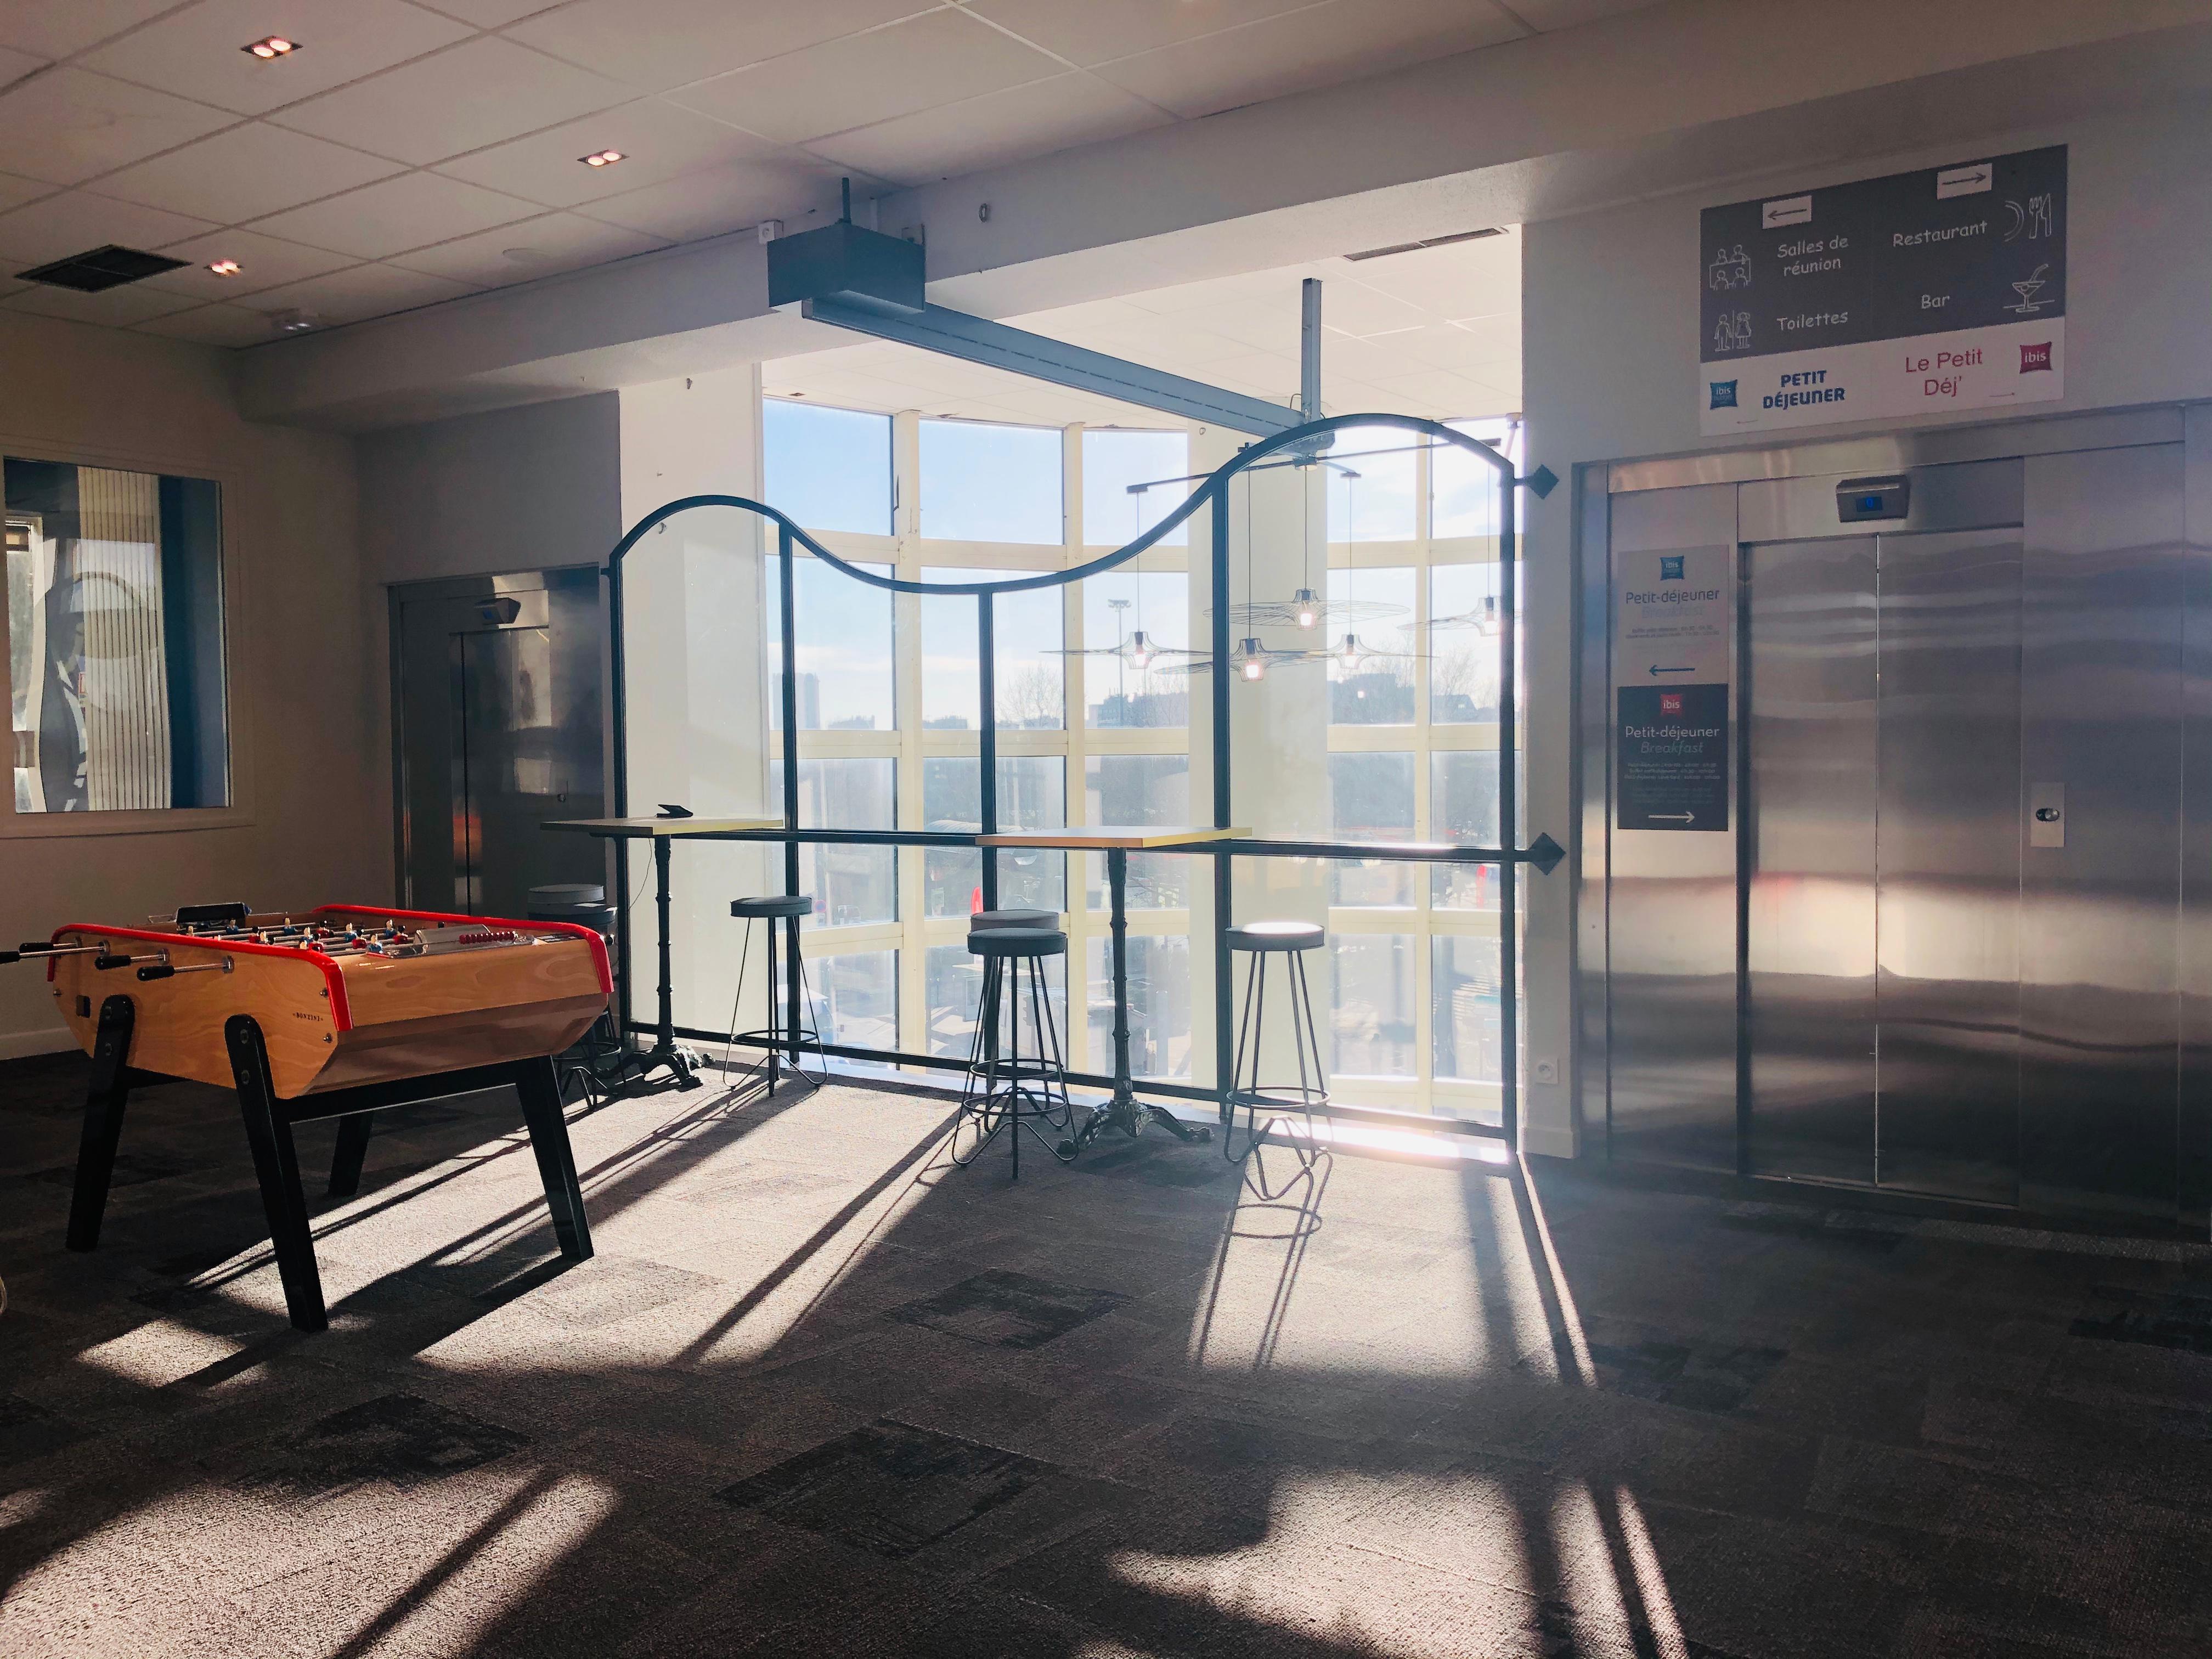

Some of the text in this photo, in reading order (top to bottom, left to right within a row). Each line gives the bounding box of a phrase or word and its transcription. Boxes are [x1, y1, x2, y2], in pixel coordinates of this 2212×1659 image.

[1893, 220, 1988, 247] Restaurant
[1778, 235, 1849, 258] Salles de
[1784, 258, 1841, 276] réunion
[1921, 294, 1950, 309] Bar
[1777, 312, 1848, 331] Toilettes
[1905, 348, 1983, 373] Le Petit
[2024, 351, 2046, 363] ibis
[1780, 370, 1827, 388] PETIT
[1924, 375, 1962, 397] Déj'
[1716, 386, 1731, 395] ibis
[1666, 561, 1679, 569] ibis
[1626, 589, 1720, 605] Petit-déjeuner
[1663, 699, 1680, 709] ibis
[1626, 725, 1720, 741] Petit-déjeuner
[1640, 741, 1704, 756] Breakfast
